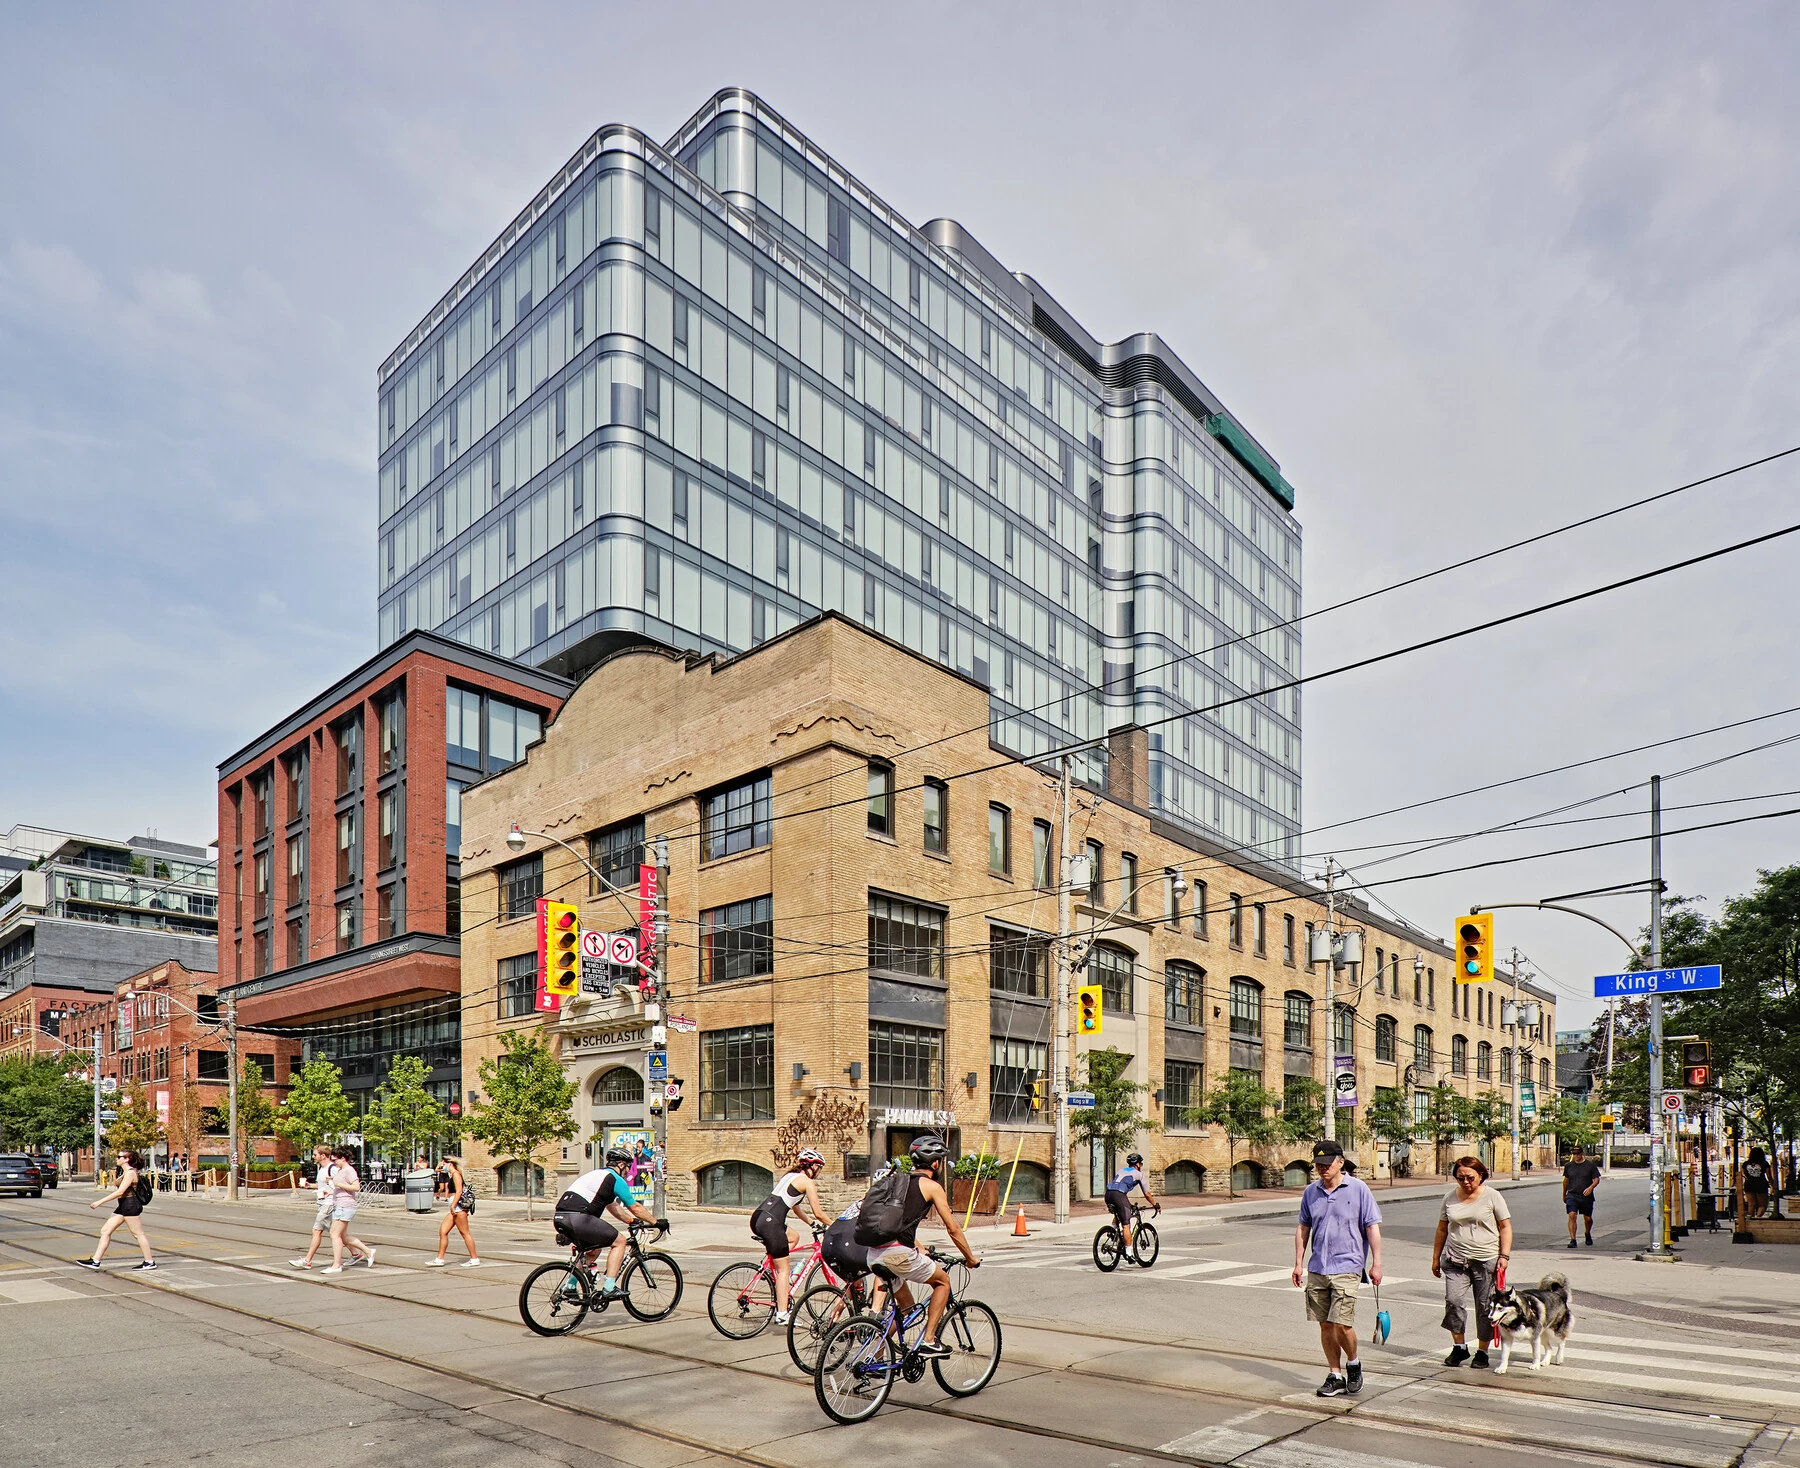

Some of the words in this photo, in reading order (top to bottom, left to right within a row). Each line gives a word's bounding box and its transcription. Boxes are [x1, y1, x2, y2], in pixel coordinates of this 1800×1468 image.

[585, 962, 605, 970] VEHICLES
[1615, 974, 1658, 991] King
[1665, 971, 1676, 980] St
[1681, 969, 1697, 985] W
[582, 1028, 645, 1047] SCHOLASTIC
[1694, 1068, 1705, 1084] 12
